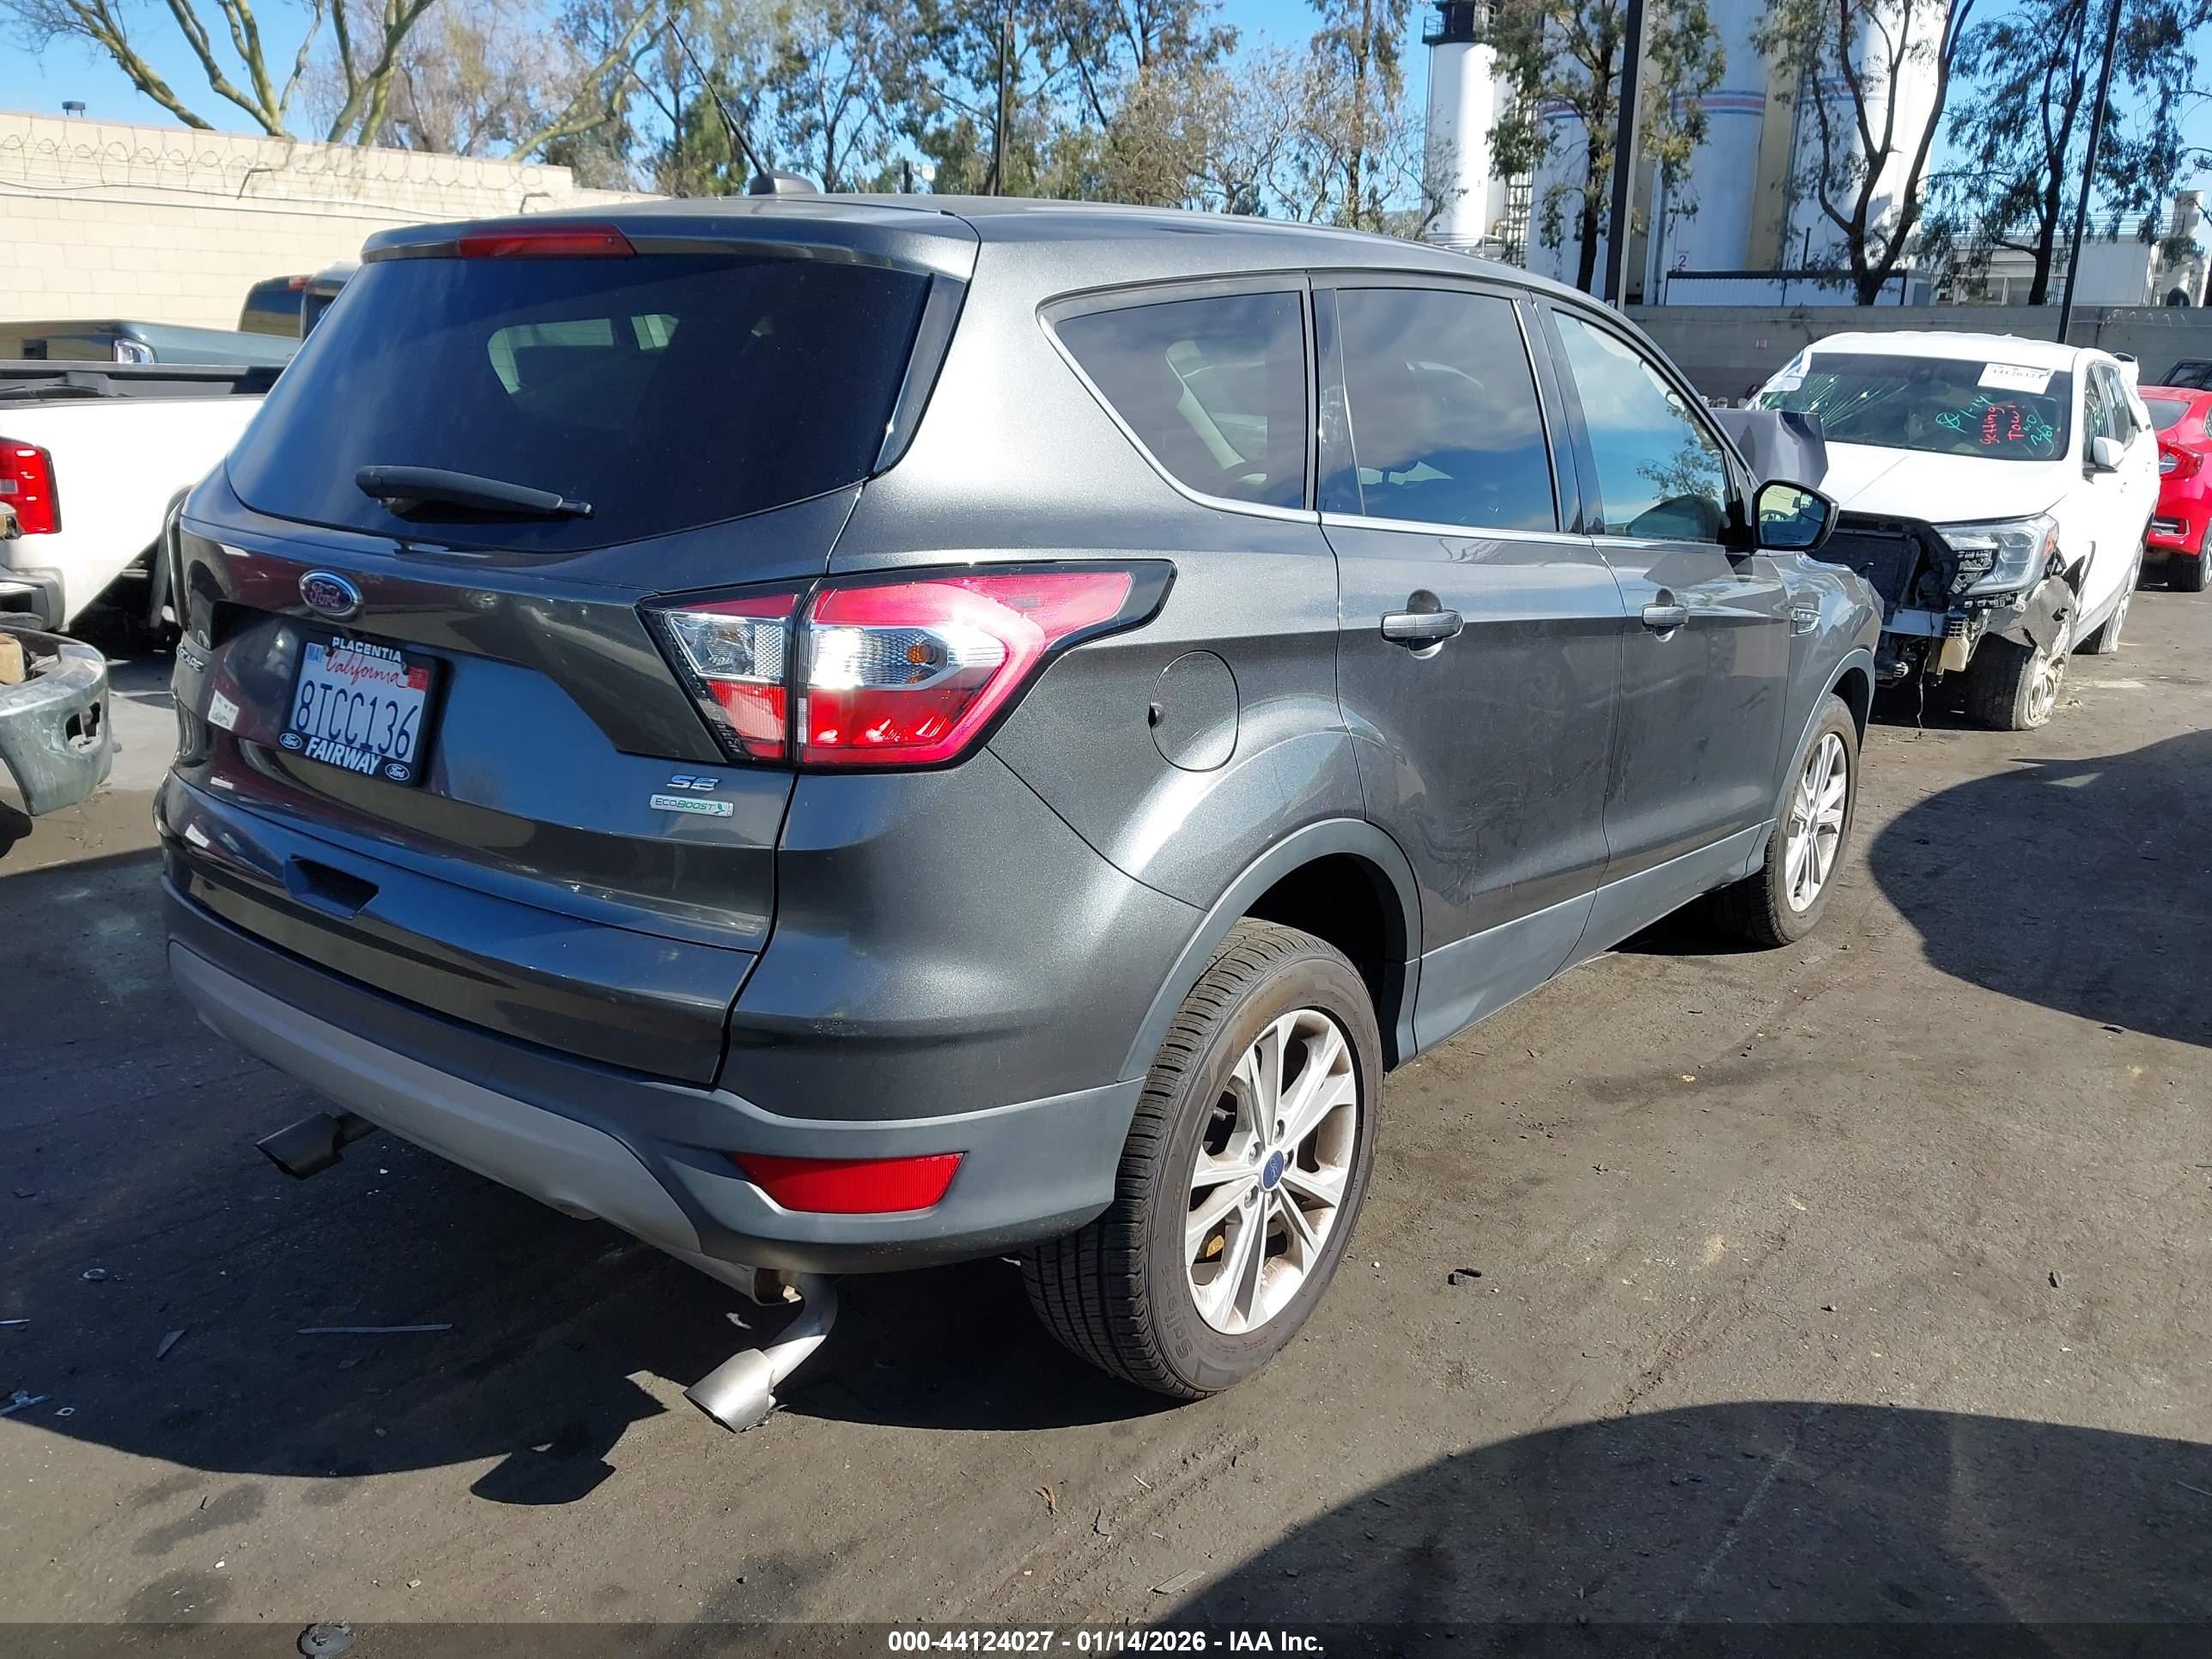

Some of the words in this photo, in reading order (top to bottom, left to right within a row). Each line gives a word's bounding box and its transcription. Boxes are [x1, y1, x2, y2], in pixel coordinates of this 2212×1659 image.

[1679, 255, 1686, 267] 2
[311, 580, 340, 607] Ford
[332, 636, 402, 663] PLACENTIA
[325, 647, 408, 689] California
[295, 680, 419, 758] 8TCC136
[304, 736, 383, 775] FAIRWAY
[666, 775, 720, 792] SE
[655, 798, 715, 811] ECOBOOST
